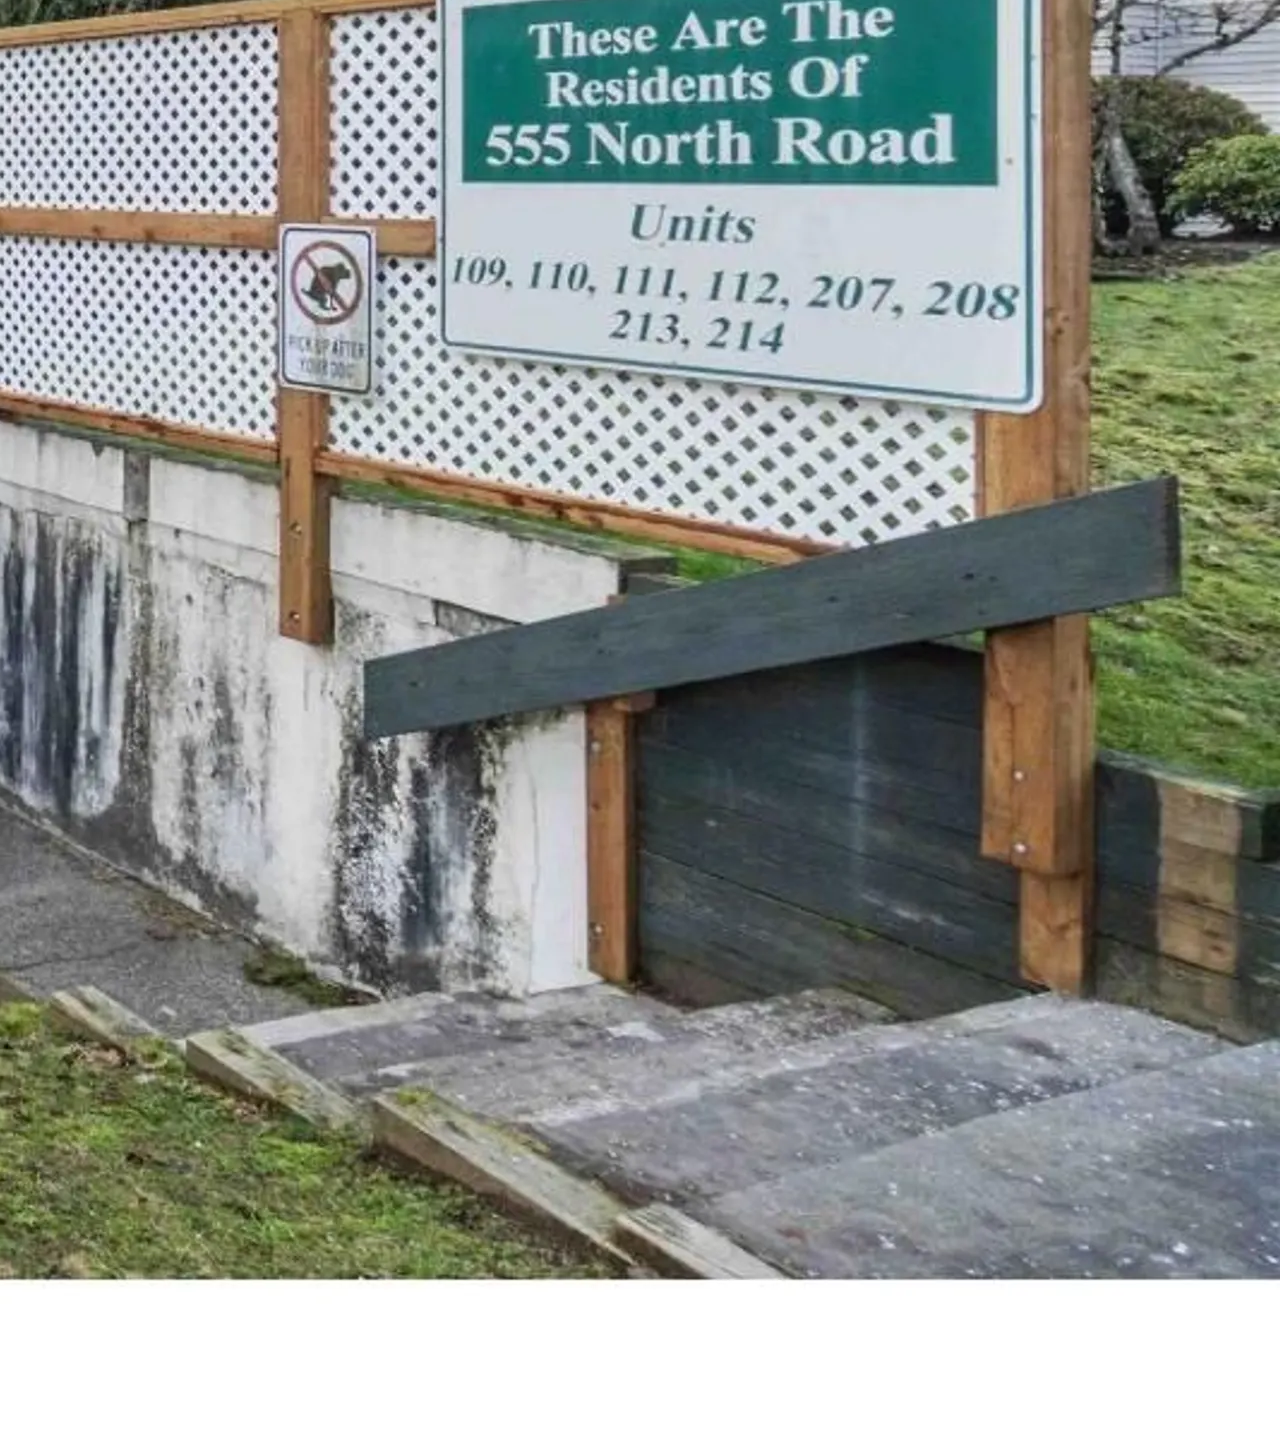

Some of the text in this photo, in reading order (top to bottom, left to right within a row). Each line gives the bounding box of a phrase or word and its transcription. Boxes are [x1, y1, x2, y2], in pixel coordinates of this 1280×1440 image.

[529, 21, 658, 60] These
[671, 10, 767, 50] Are
[547, 54, 869, 107] Residents Of
[484, 113, 957, 167] 555 North Road
[630, 203, 756, 244] Units
[614, 266, 688, 303] 111,
[706, 271, 790, 310] 112,
[807, 274, 904, 319] 207,
[922, 281, 1020, 321] 208
[705, 315, 785, 354] 214
